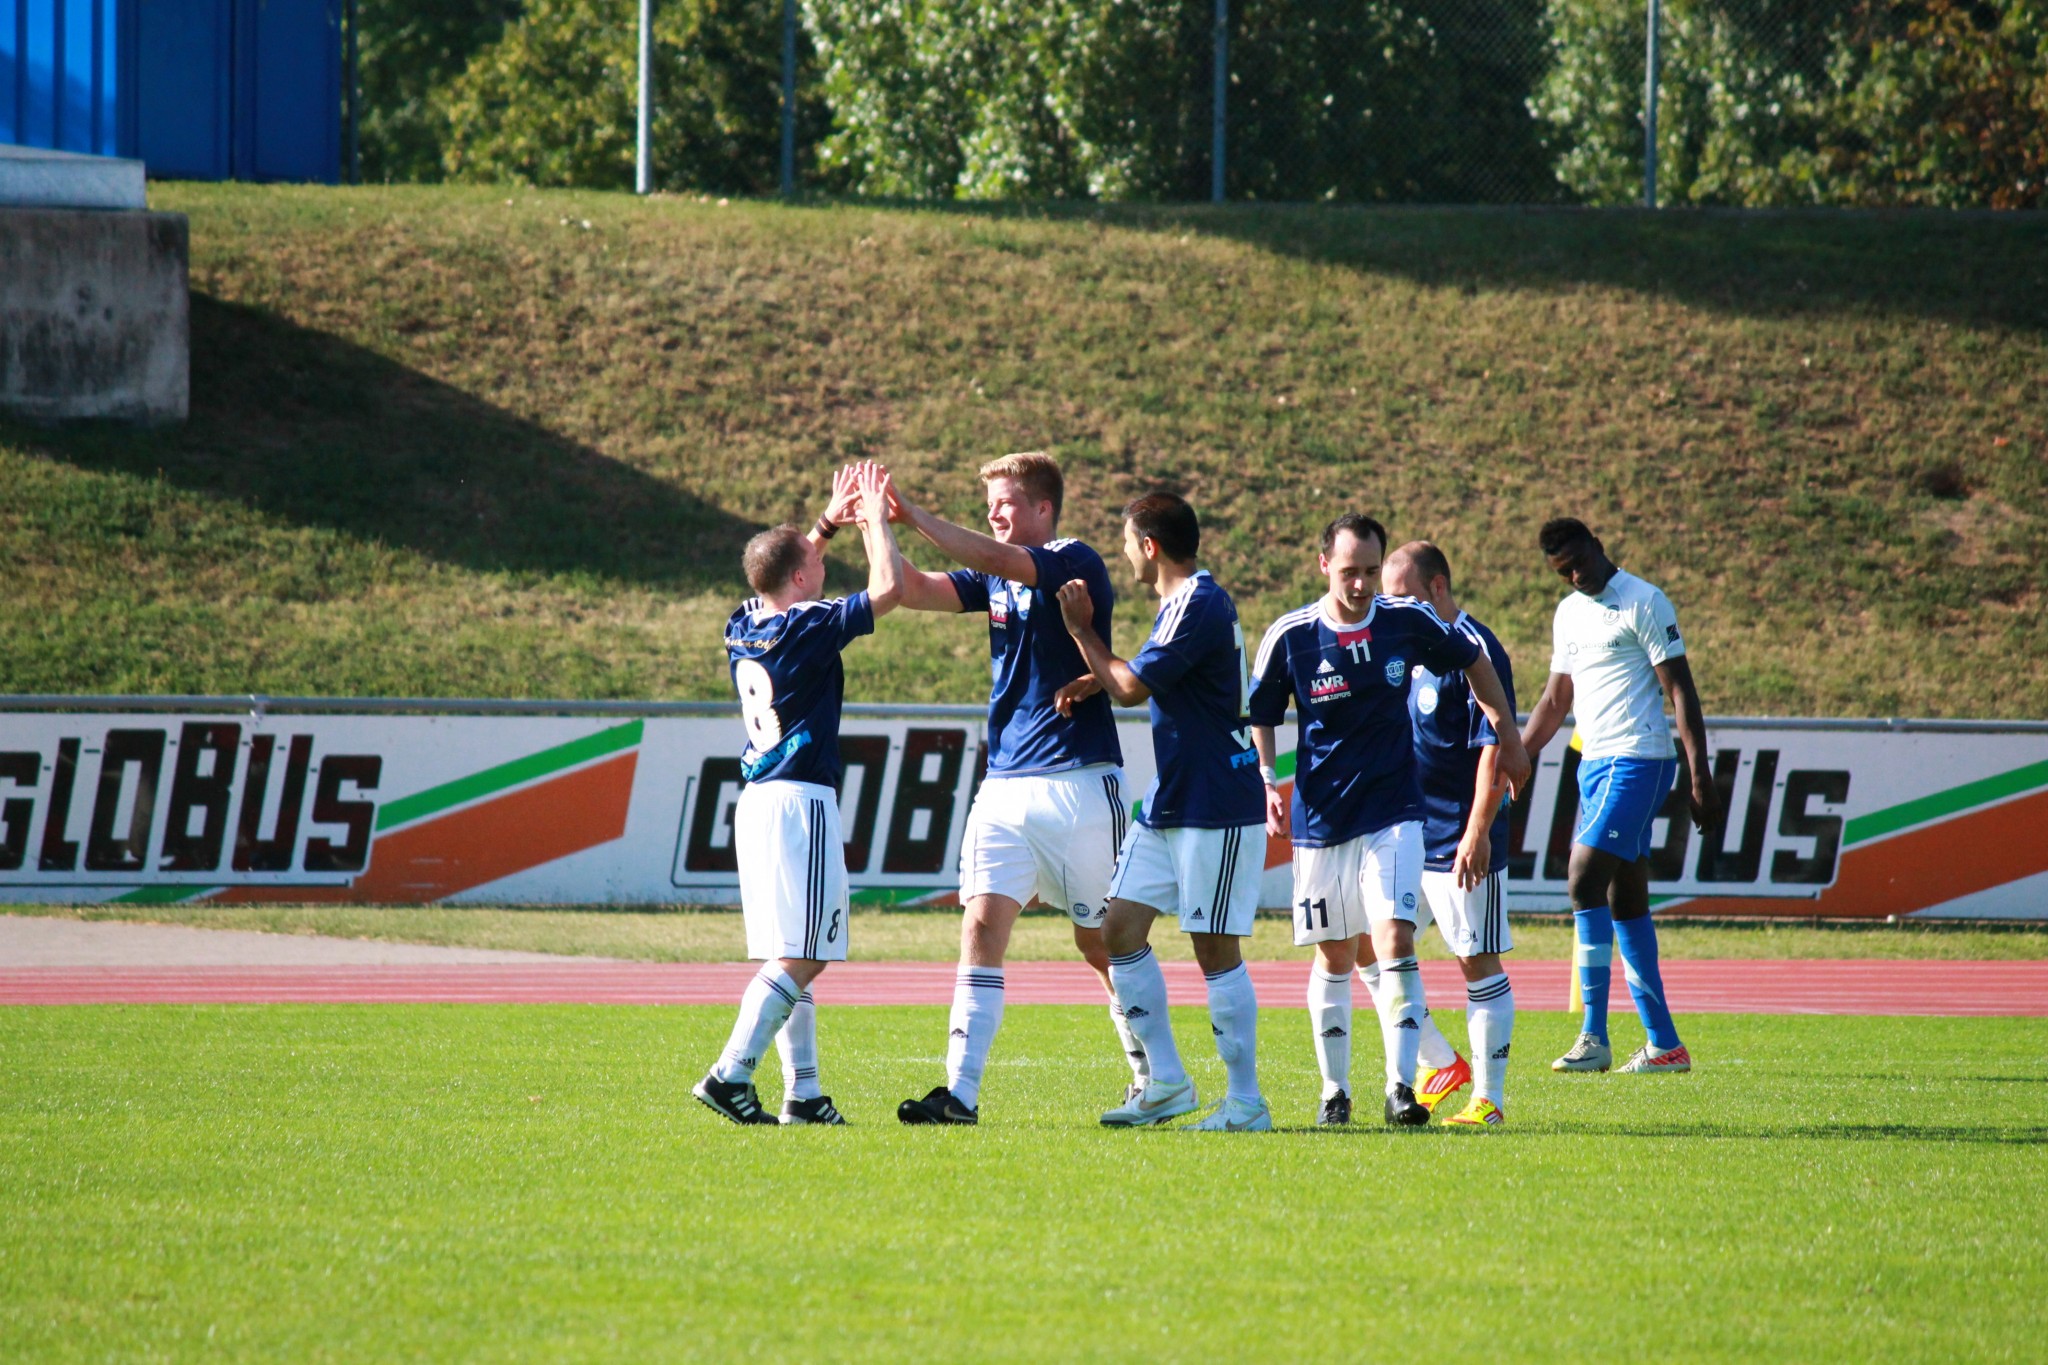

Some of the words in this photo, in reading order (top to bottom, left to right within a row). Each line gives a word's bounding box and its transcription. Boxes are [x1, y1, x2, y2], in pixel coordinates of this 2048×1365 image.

[1346, 638, 1371, 664] 11
[1311, 674, 1345, 693] KVR
[735, 658, 783, 753] 8
[826, 908, 841, 944] 8
[1298, 898, 1329, 931] 11
